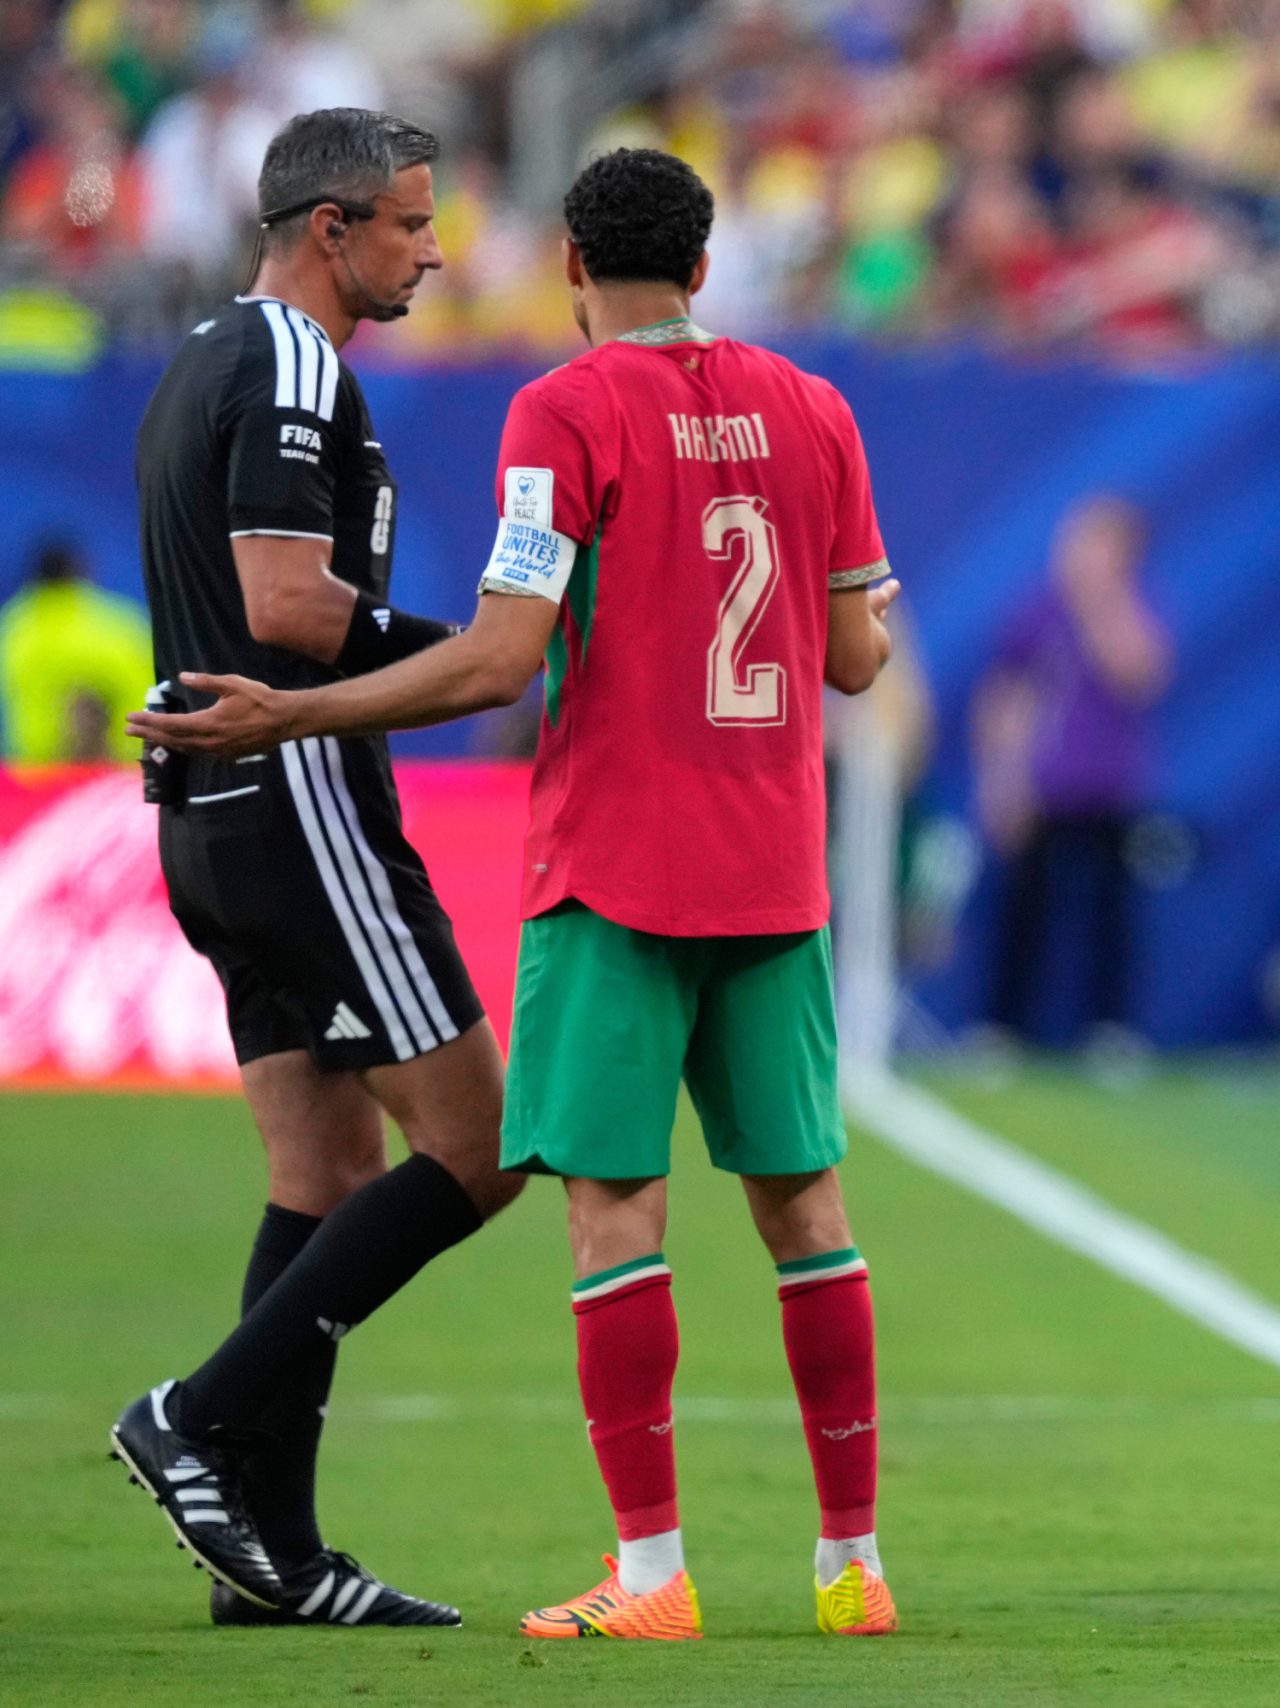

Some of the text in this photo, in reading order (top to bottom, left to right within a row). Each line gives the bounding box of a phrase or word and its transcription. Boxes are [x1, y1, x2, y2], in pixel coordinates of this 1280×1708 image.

[280, 424, 321, 450] FIFA
[502, 536, 559, 564] UNITES
[506, 523, 560, 550] FOOTBALL
[512, 555, 556, 579] World
[702, 495, 786, 727] 2
